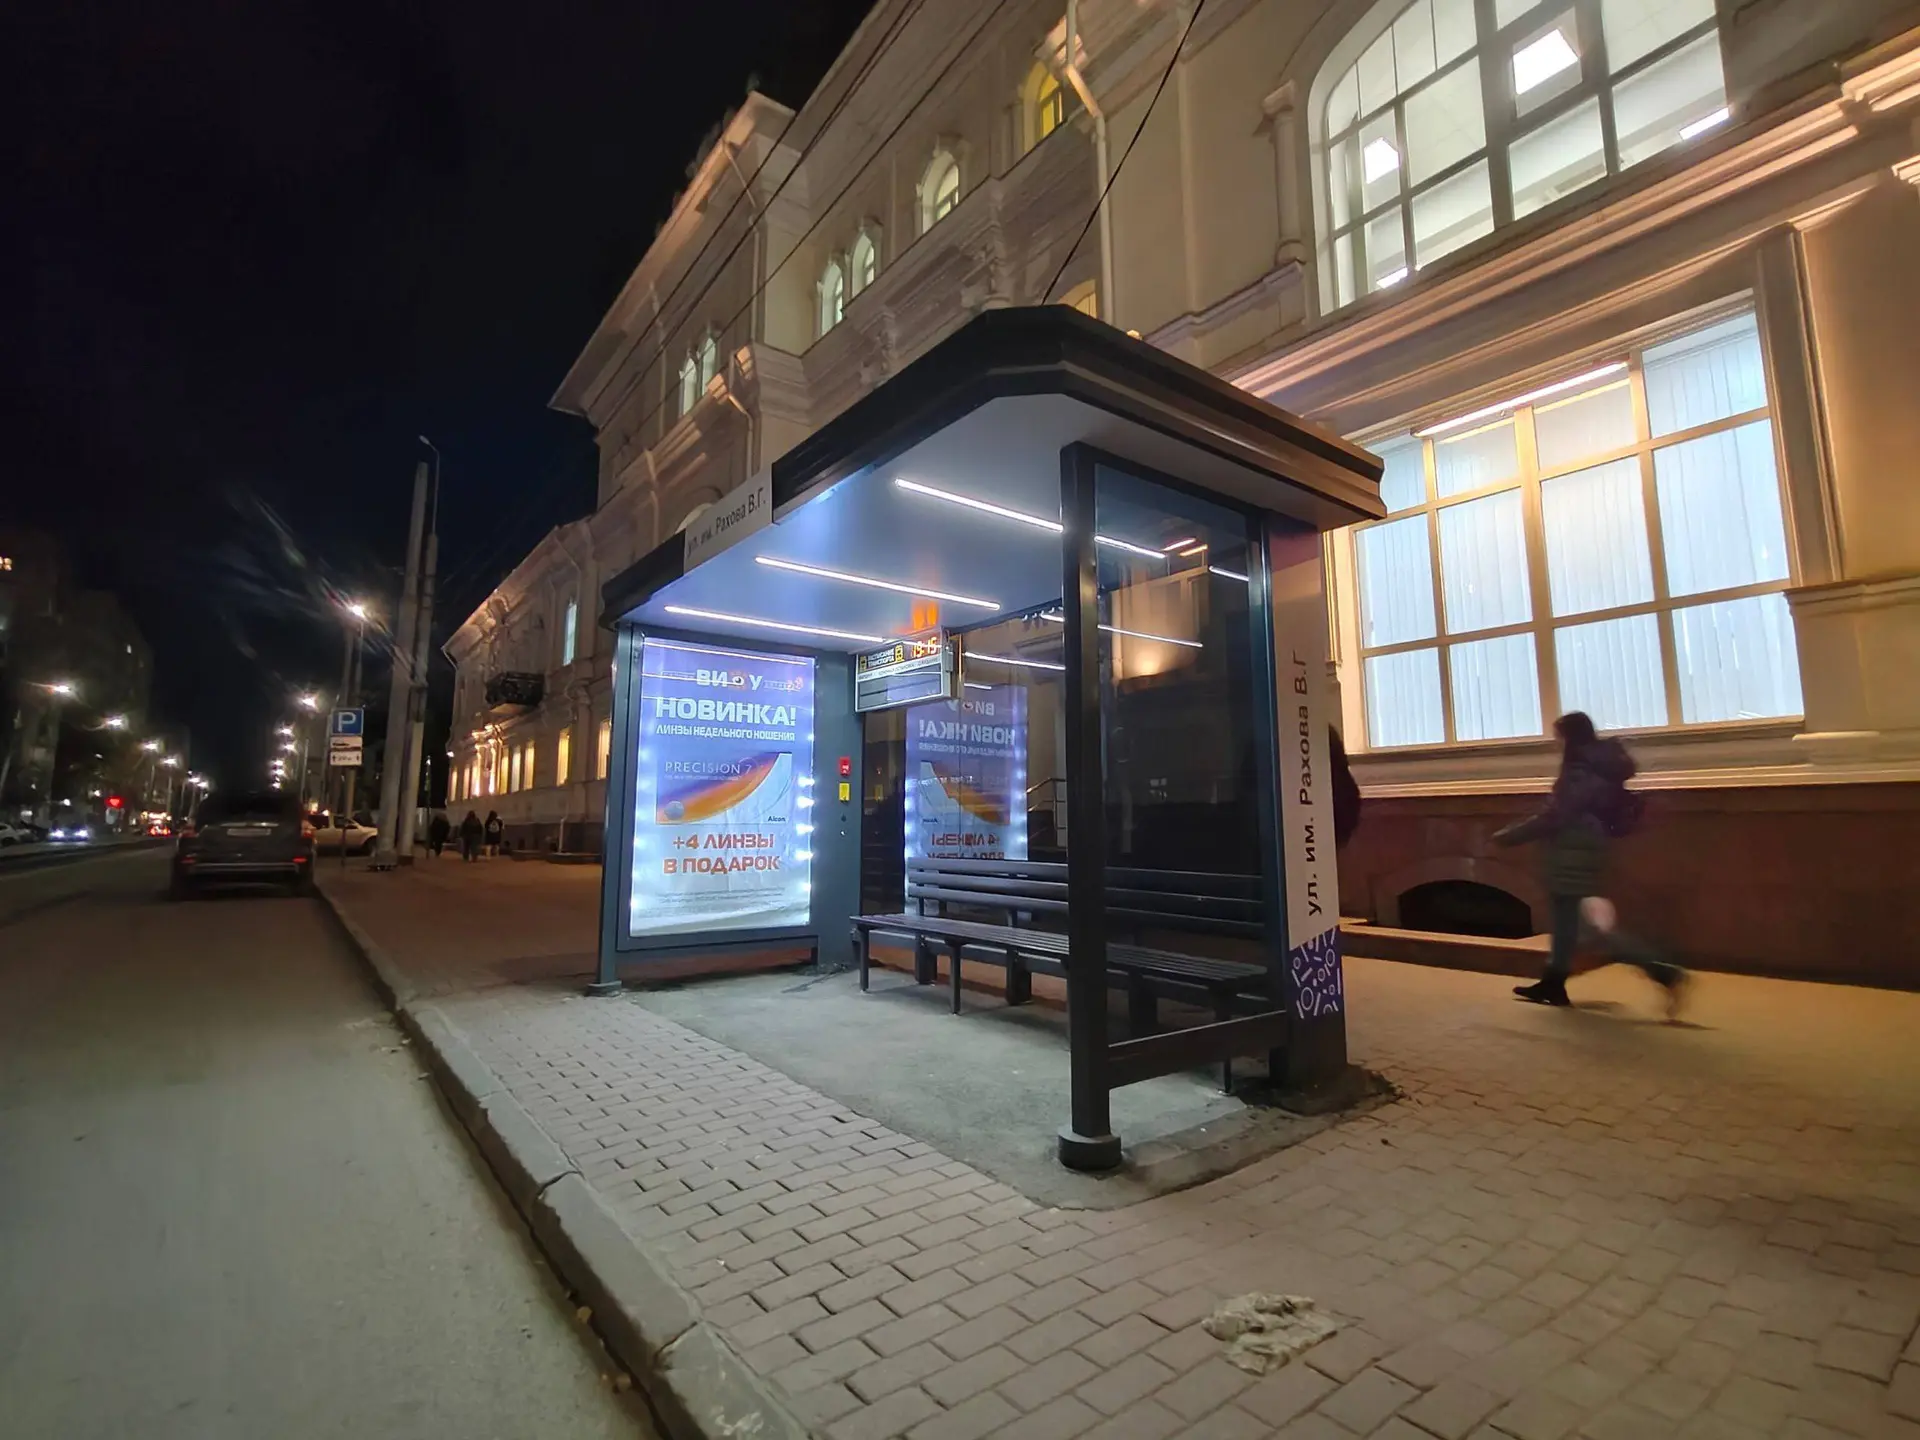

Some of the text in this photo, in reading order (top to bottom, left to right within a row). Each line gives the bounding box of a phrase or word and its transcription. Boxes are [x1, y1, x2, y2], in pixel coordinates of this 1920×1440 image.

[715, 504, 746, 534] Рахова
[338, 711, 356, 732] P
[655, 697, 796, 727] НОВИНКА!
[656, 725, 796, 742] ЛИНЗЫ НЕДЕЛЬНОГО НОШЕНИЯ
[665, 761, 741, 775] PRECISION
[1293, 649, 1322, 916] ул. им. Рахова В.Г
[767, 815, 786, 823] Alcon
[673, 833, 774, 850] +4 ЛИНЗЫ
[663, 856, 781, 875] В ПОДАРОК
